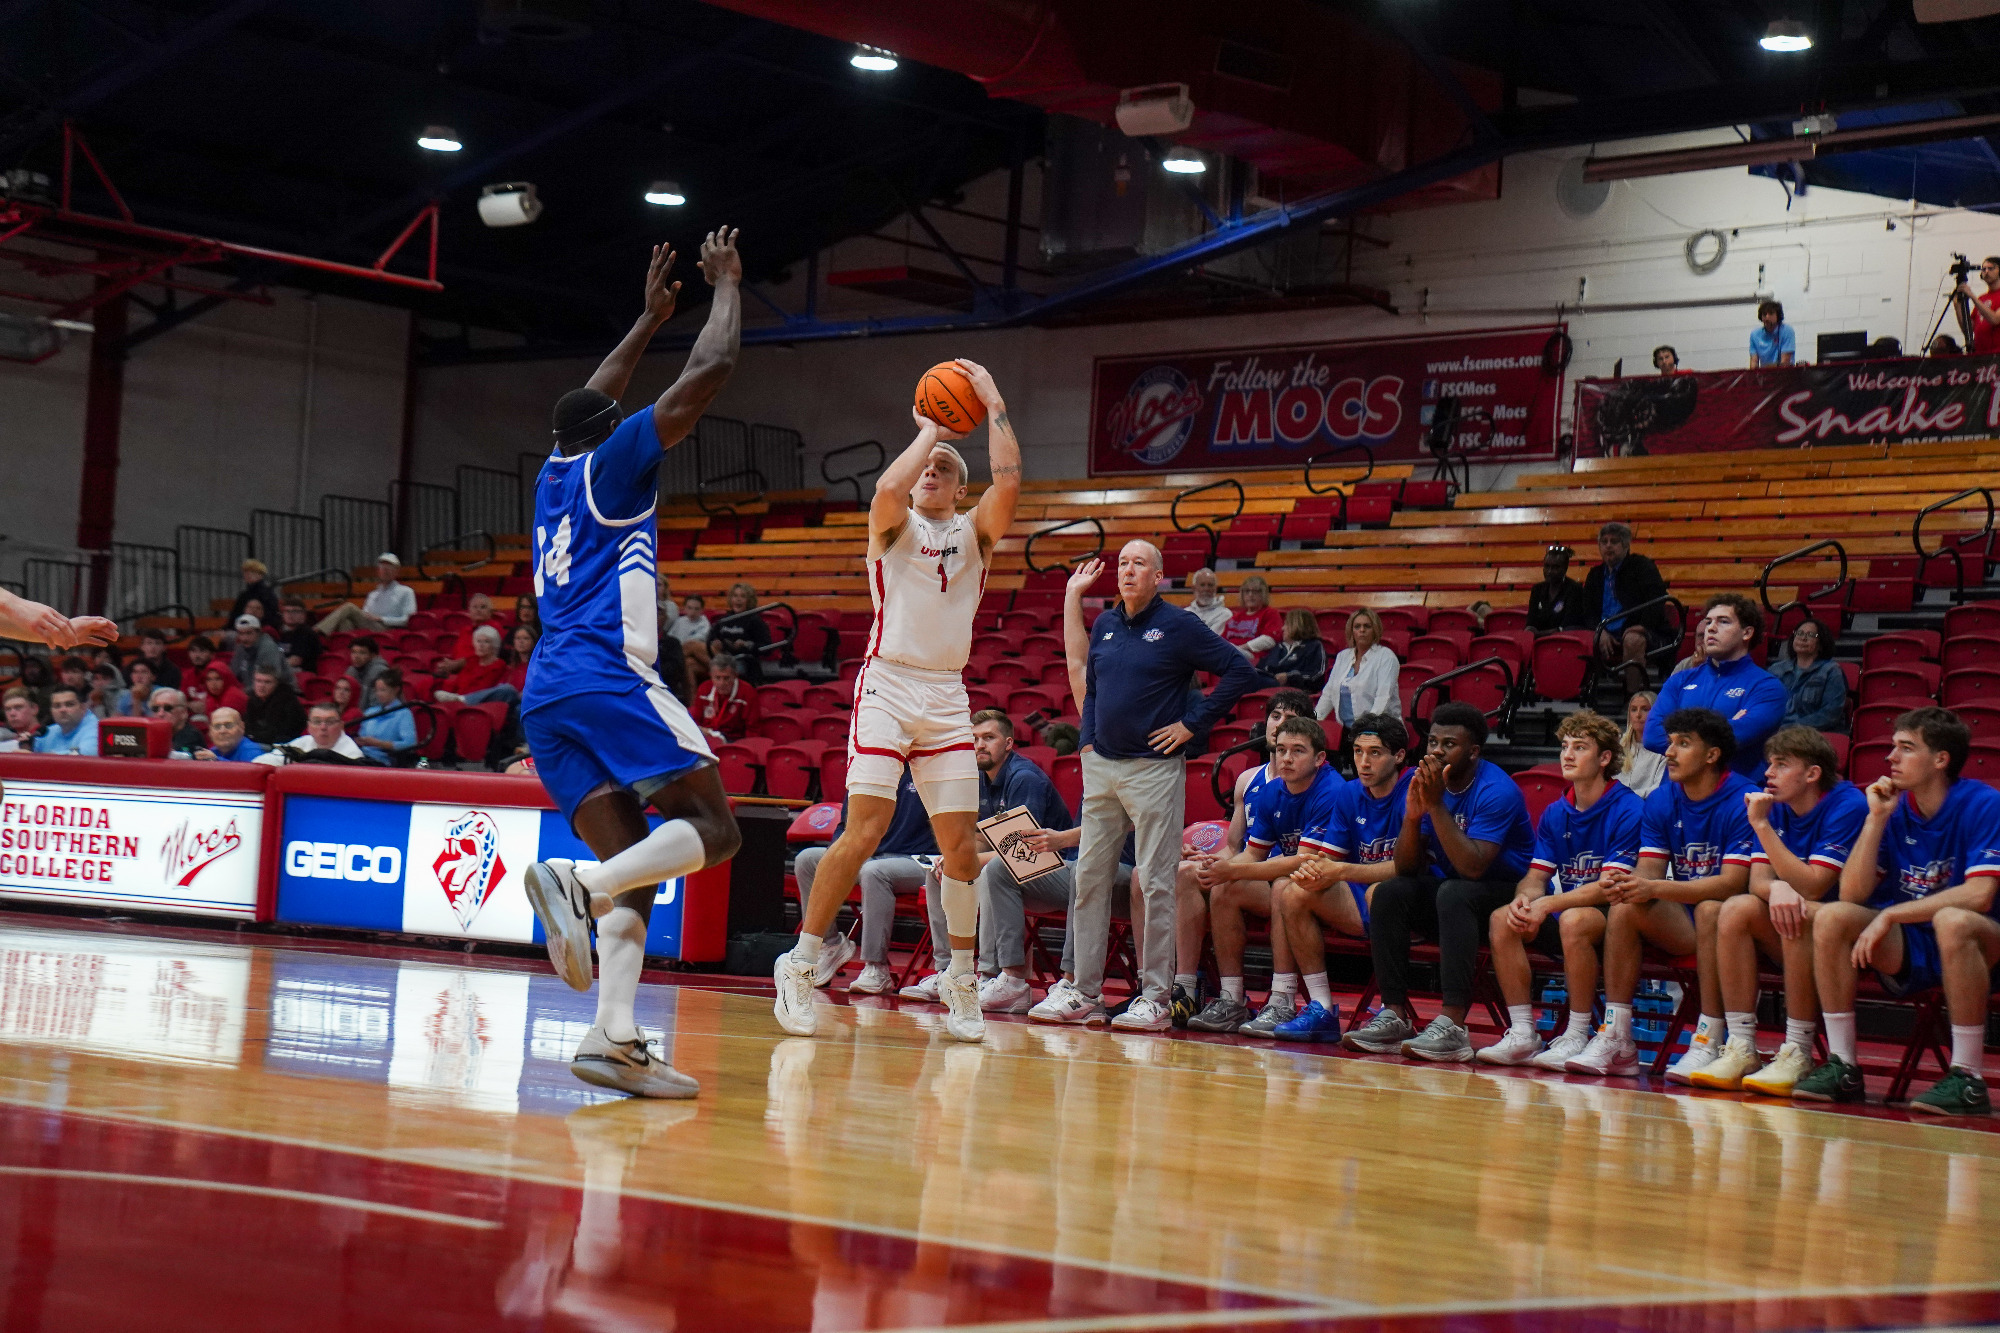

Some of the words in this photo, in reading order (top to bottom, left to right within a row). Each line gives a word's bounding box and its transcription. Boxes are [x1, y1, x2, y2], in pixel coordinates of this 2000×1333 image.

[1207, 357, 1286, 391] Follow
[1291, 353, 1331, 386] the
[1848, 371, 1943, 391] Welcome
[1948, 367, 1971, 385] to
[1441, 381, 1497, 397] FSCMocs
[1106, 379, 1204, 451] Mocs
[1208, 375, 1405, 451] MOCS
[1775, 383, 1965, 443] Snake
[937, 563, 948, 592] 1
[3, 803, 111, 829] FLORIDA
[1, 828, 140, 857] SOUTHERN
[160, 815, 243, 889] Mocs
[0, 853, 113, 882] COLLEGE
[285, 840, 402, 884] GEICO
